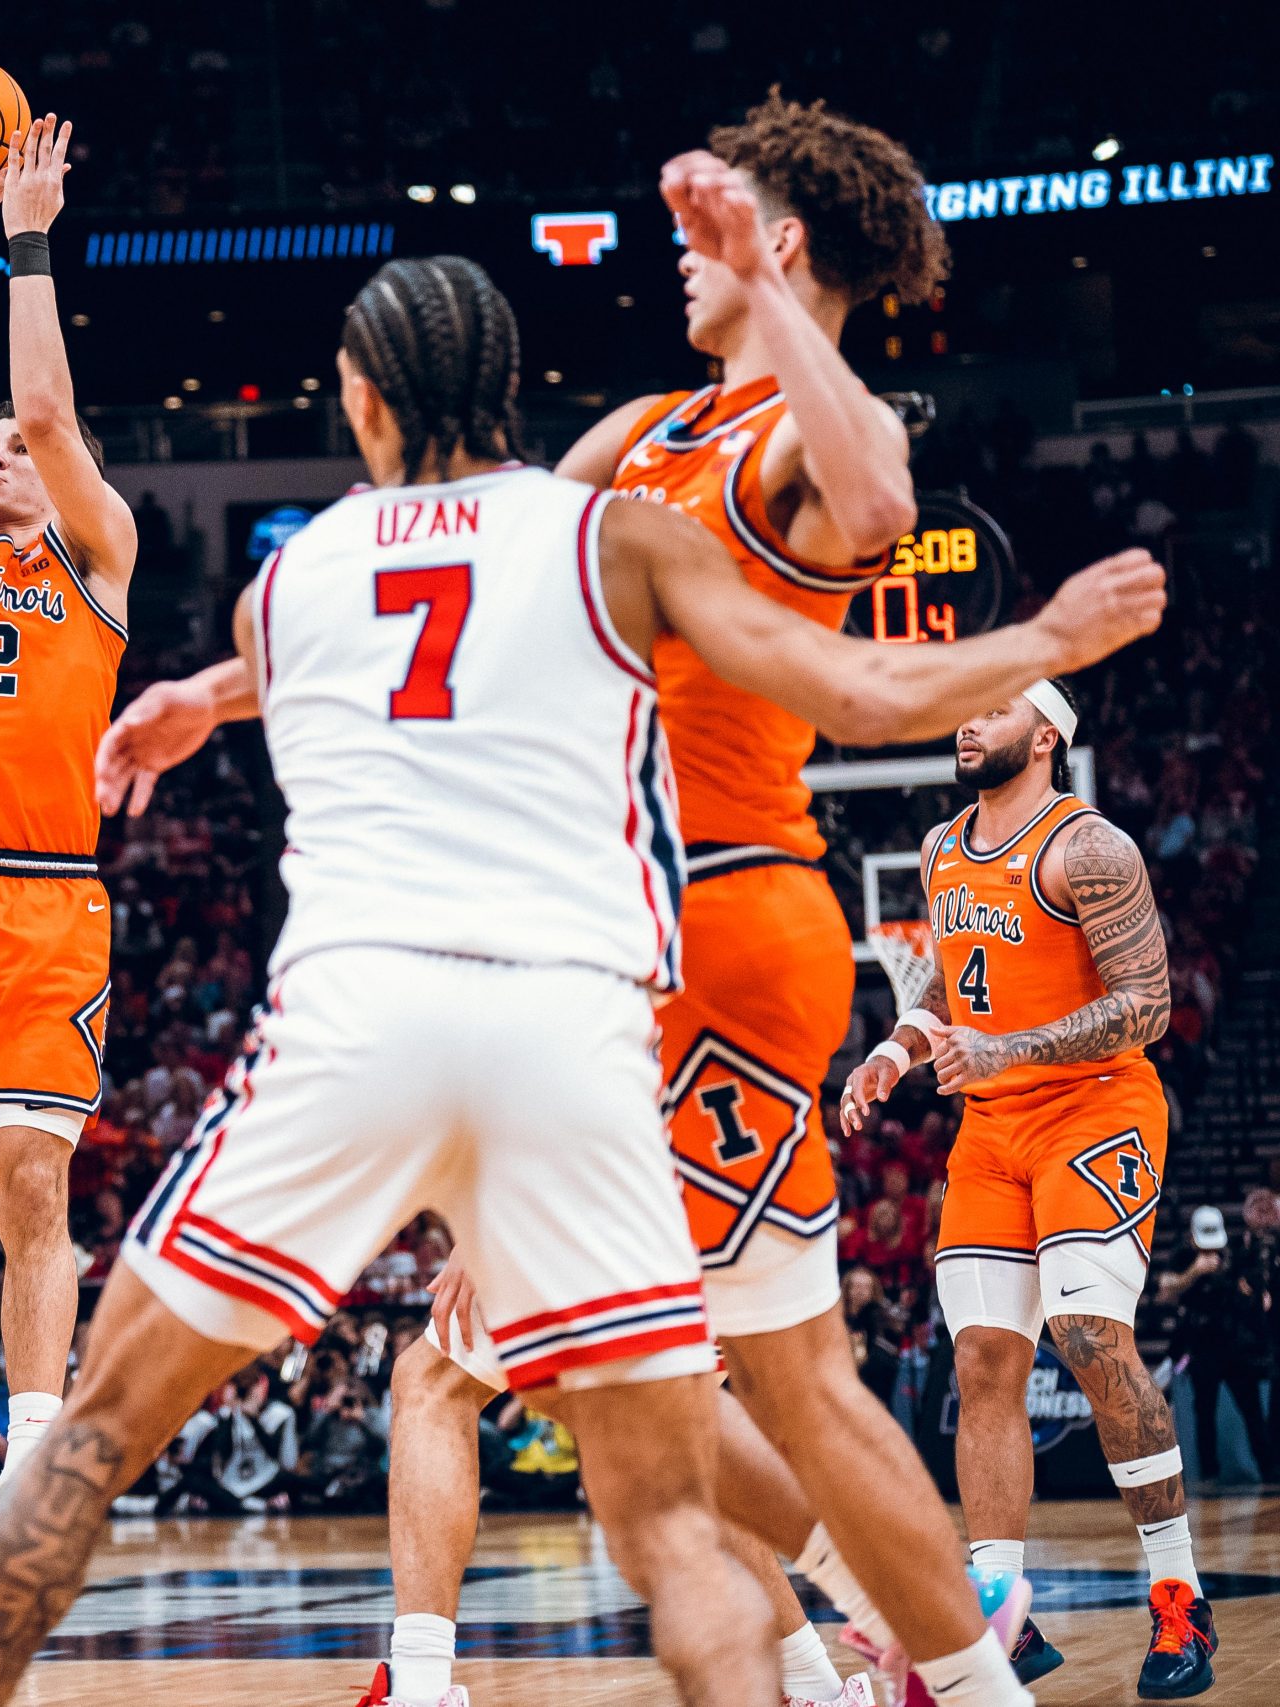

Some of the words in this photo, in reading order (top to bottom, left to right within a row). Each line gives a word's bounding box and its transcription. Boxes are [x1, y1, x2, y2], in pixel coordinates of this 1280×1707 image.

[1119, 154, 1274, 205] ILLINI
[376, 497, 480, 547] UZAN
[375, 560, 474, 721] 7
[931, 882, 1025, 945] Illinois
[956, 945, 993, 1015] 4
